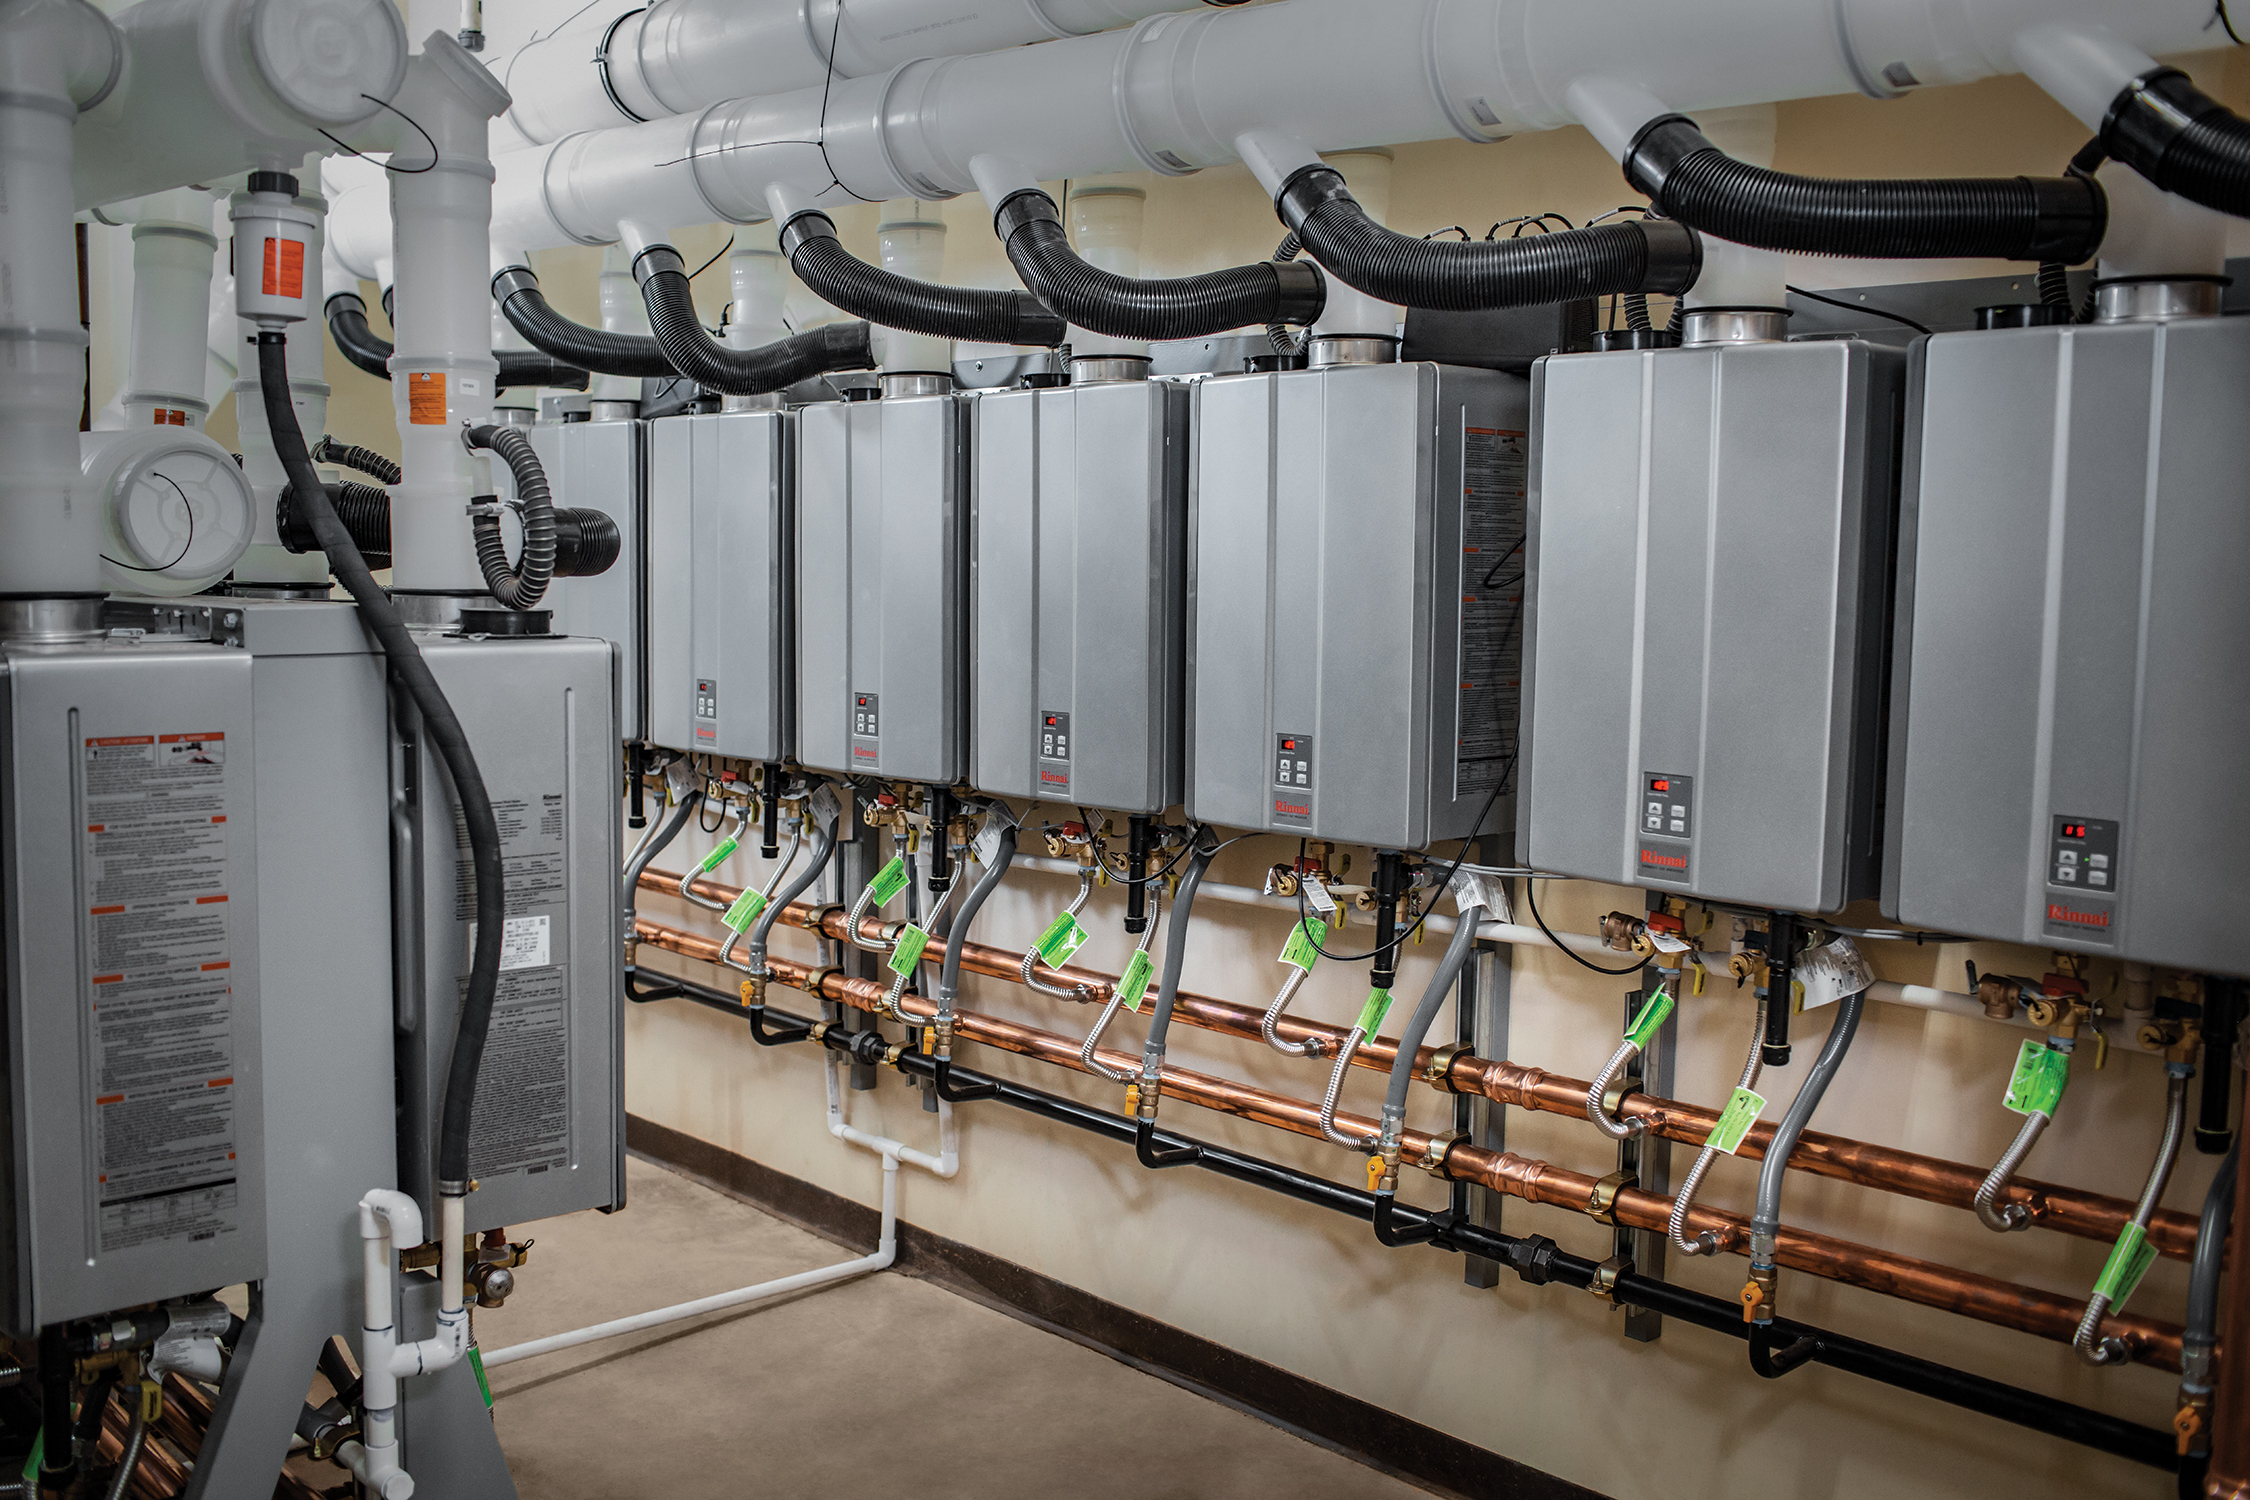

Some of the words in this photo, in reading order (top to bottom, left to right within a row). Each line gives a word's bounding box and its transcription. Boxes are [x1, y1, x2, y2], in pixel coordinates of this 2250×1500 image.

[1041, 771, 1068, 783] Rinnai
[1275, 800, 1309, 815] Rinnai
[1641, 850, 1687, 868] Rinnai
[2048, 904, 2109, 926] Rinnai
